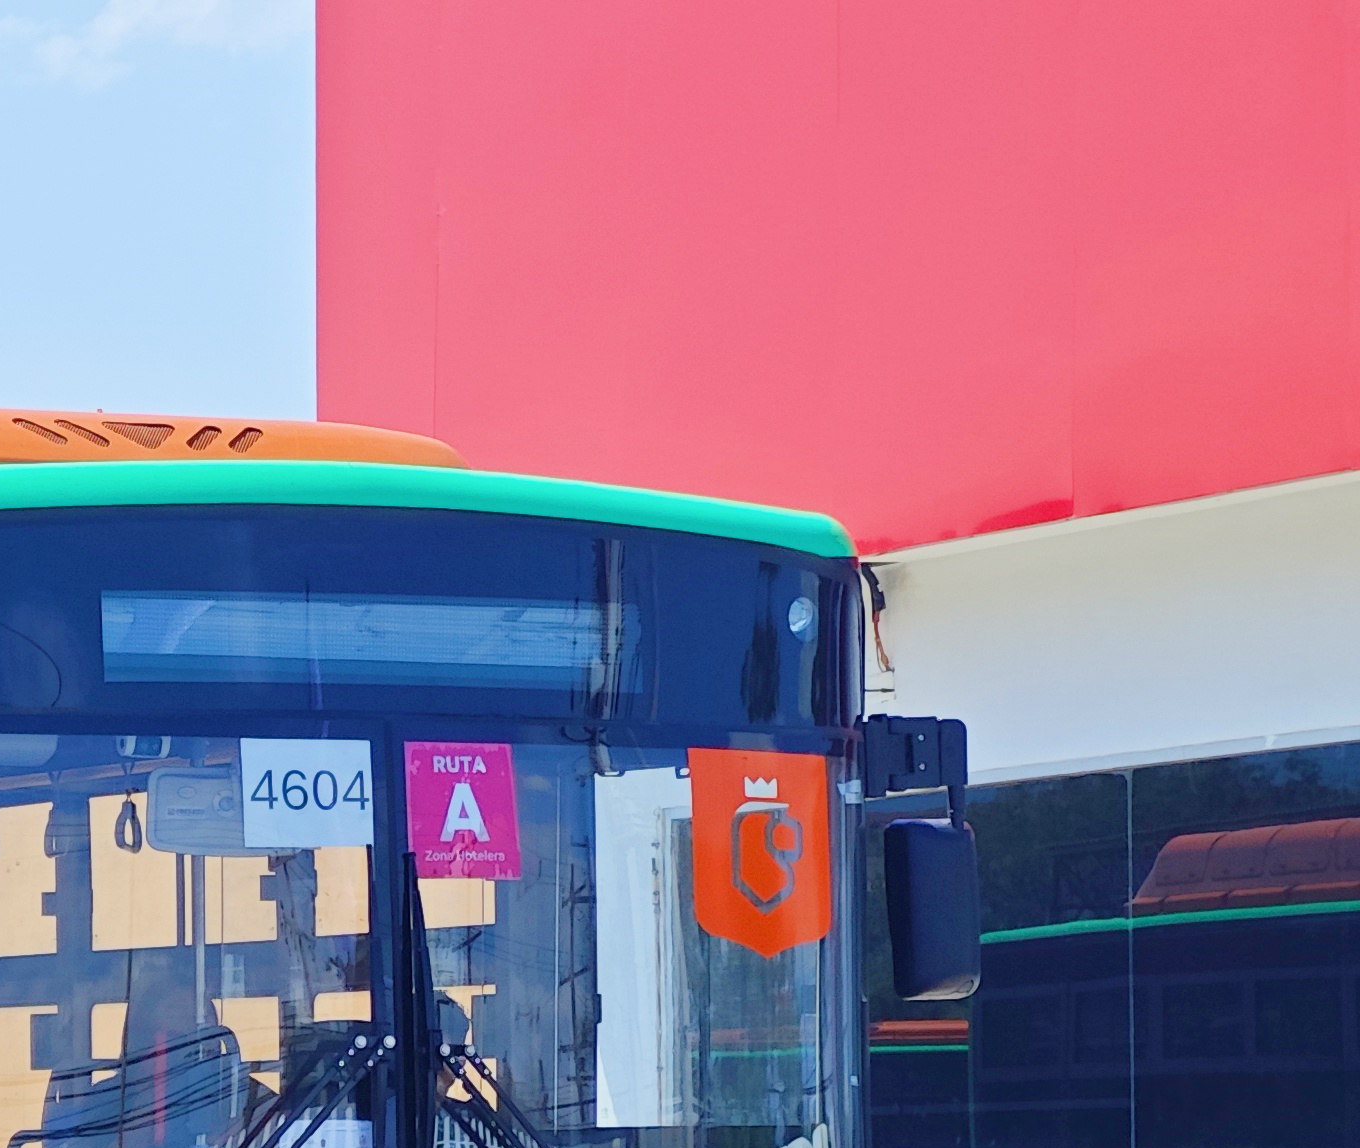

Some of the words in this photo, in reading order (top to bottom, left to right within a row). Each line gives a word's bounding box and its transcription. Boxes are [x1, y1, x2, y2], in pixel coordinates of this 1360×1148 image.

[433, 755, 486, 774] RUTA
[250, 769, 370, 811] 4604
[440, 782, 490, 842] A
[425, 850, 454, 862] Zona
